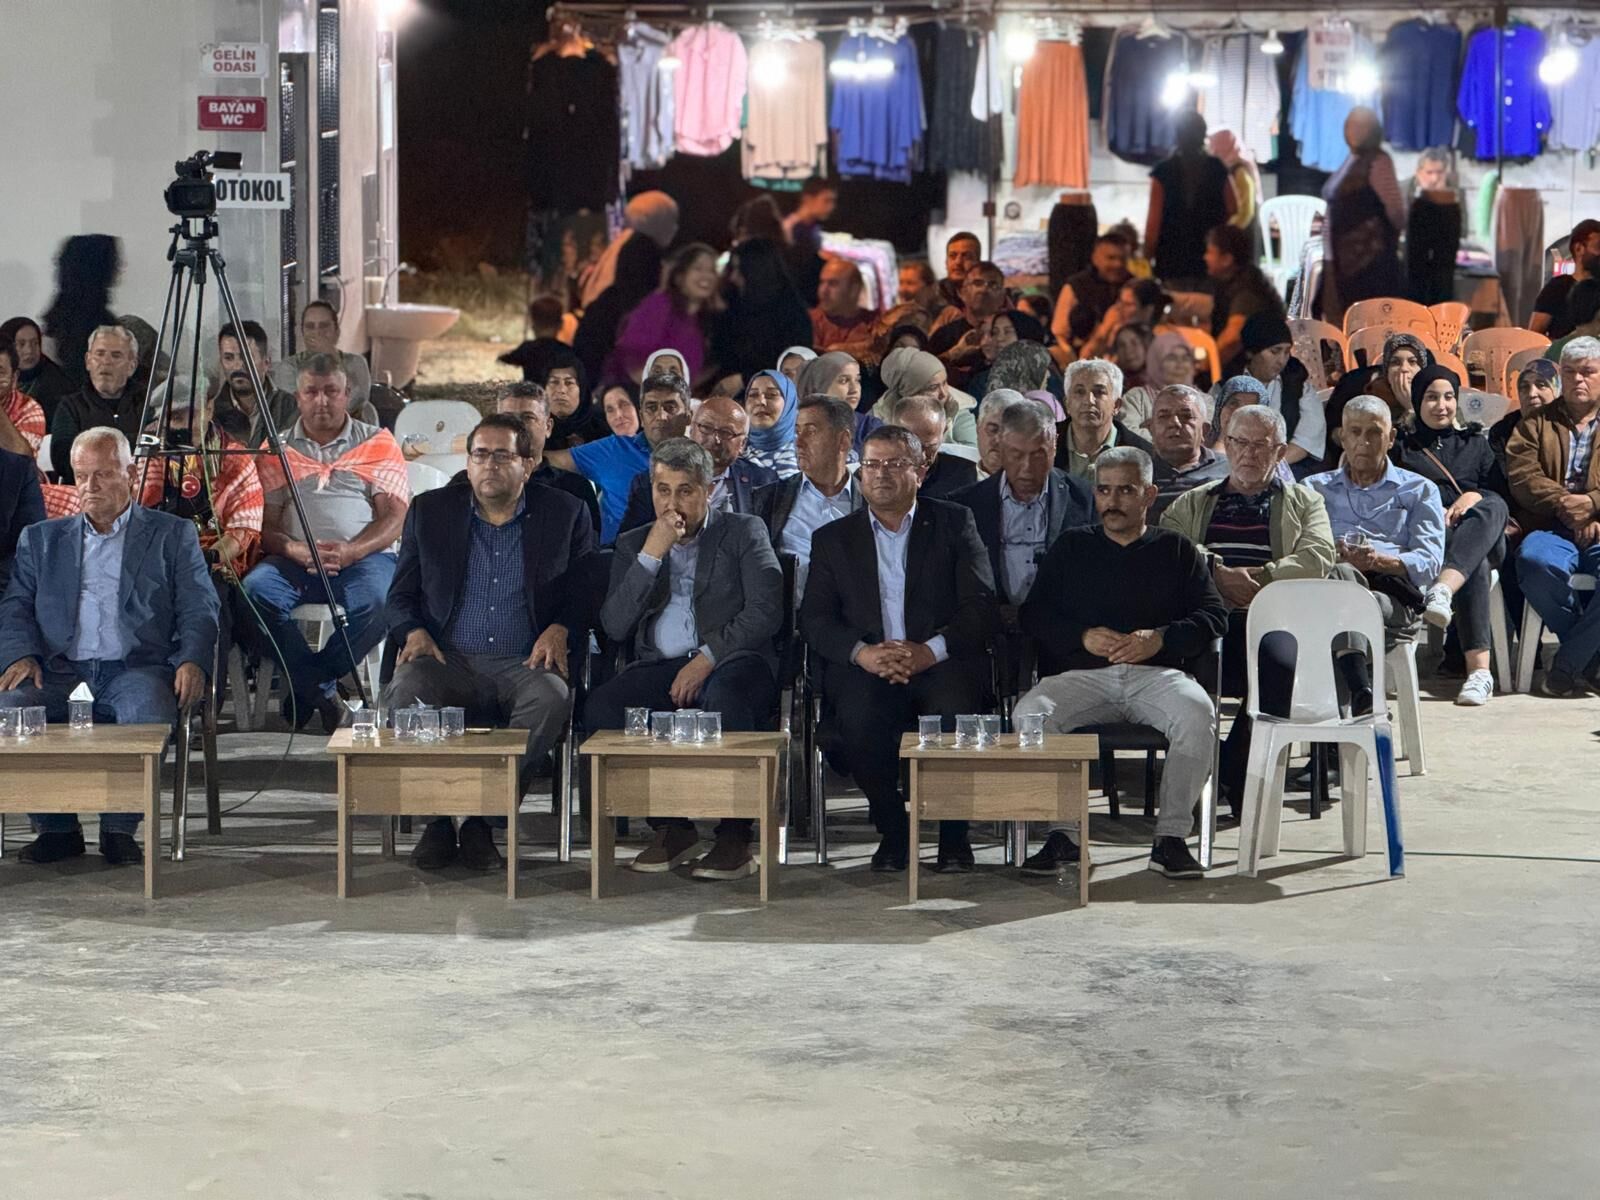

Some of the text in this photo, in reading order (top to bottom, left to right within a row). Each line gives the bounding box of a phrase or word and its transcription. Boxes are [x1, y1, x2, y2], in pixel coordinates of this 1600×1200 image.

[213, 49, 256, 61] GELİN
[213, 62, 256, 72] ODASI
[209, 102, 256, 113] BAYAN
[221, 114, 244, 125] WC
[216, 179, 285, 201] OTOKOL
